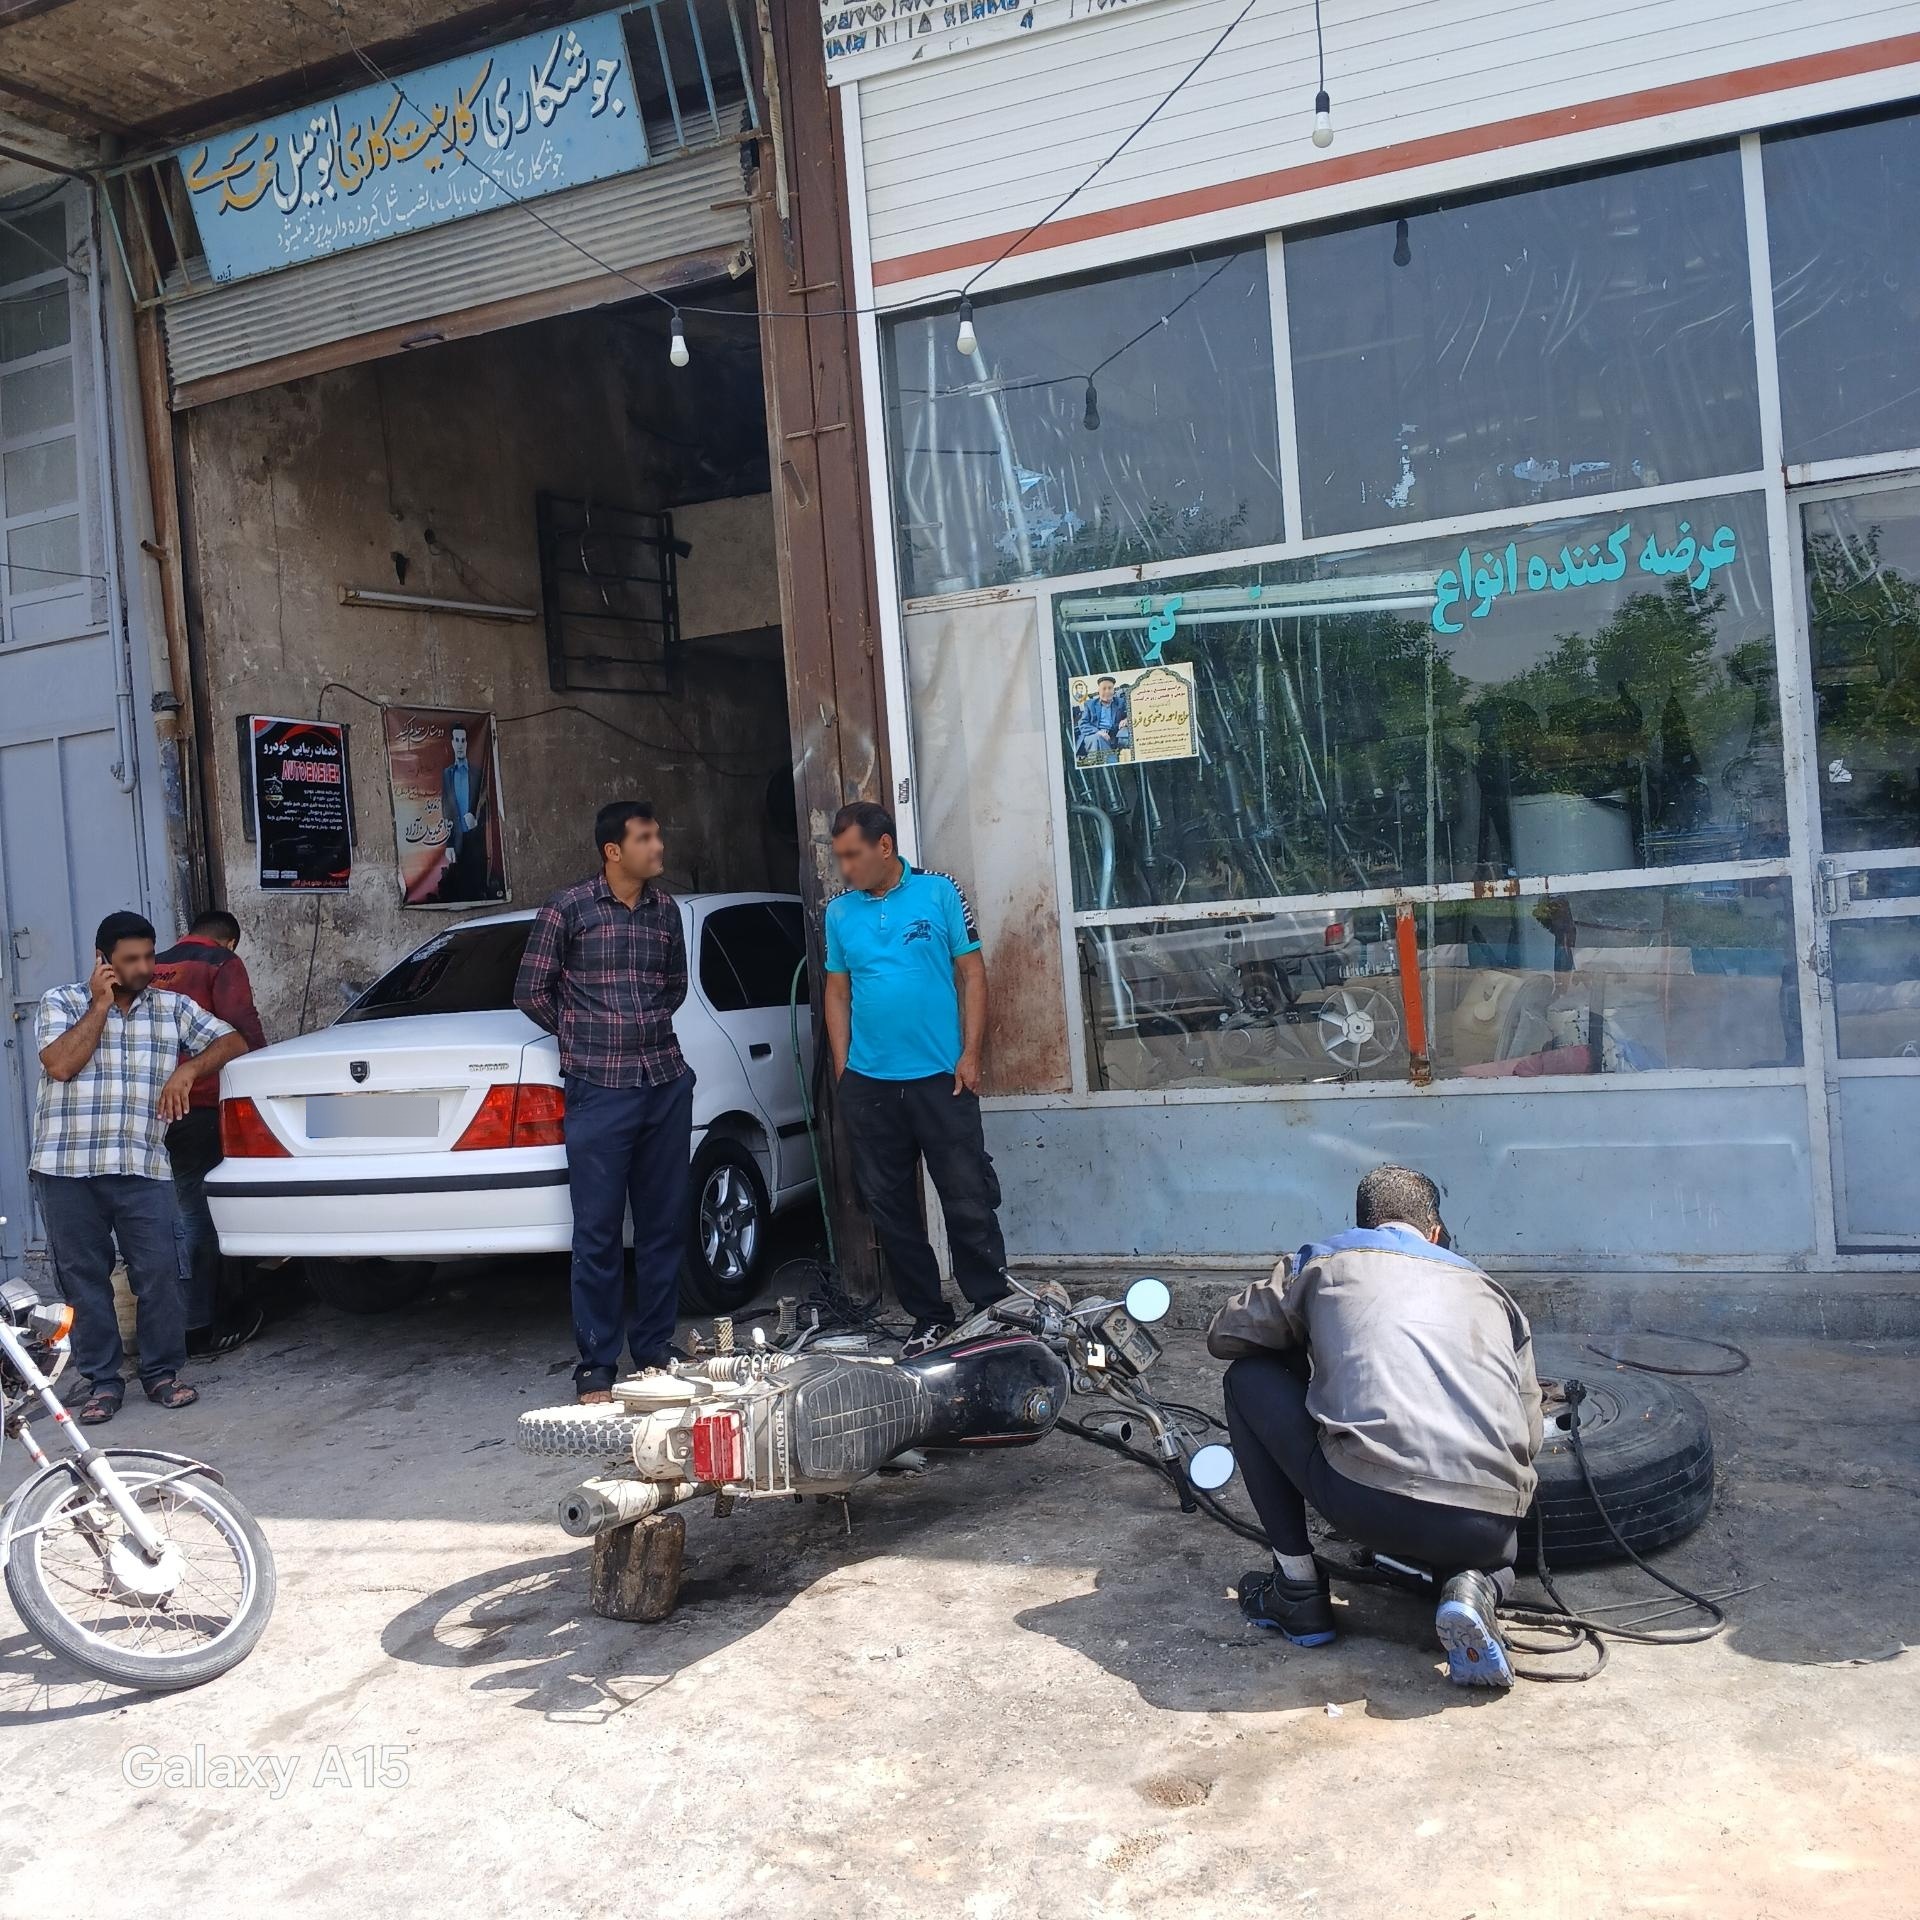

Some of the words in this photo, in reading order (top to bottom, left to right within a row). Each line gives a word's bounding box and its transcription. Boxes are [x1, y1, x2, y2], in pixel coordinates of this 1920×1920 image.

[482, 30, 627, 150] جوشکاری
[511, 138, 565, 189] جوشکاری
[1433, 542, 1518, 635] انواع
[1527, 523, 1631, 592] کننده
[1640, 520, 1737, 591] عرضه
[263, 740, 290, 756] خودرو
[314, 744, 338, 757] خدمات
